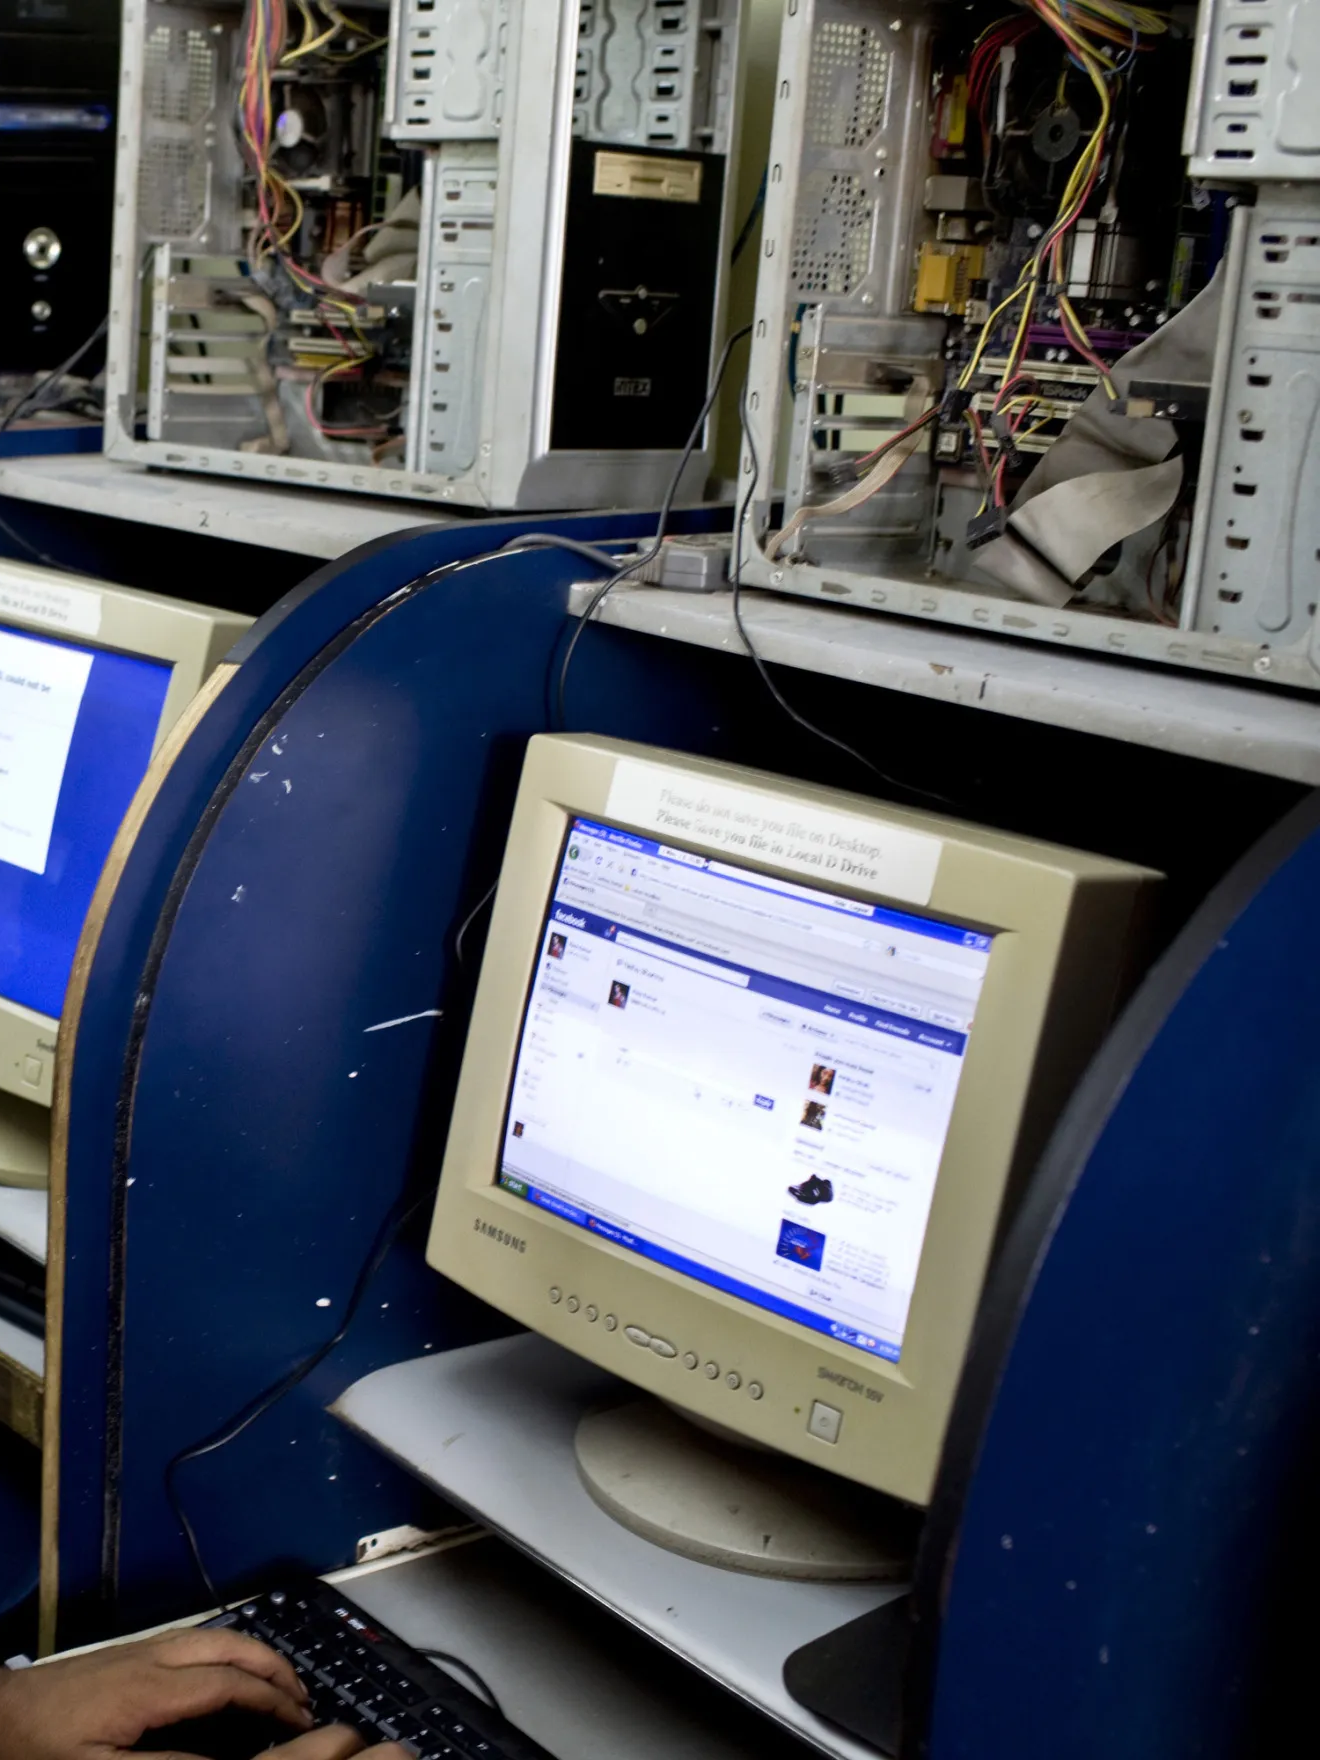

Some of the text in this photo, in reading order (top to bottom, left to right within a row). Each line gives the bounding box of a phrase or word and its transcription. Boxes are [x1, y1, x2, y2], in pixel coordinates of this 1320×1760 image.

[199, 510, 209, 528] 2
[660, 788, 693, 810] Please
[696, 799, 711, 814] do
[712, 807, 731, 820] not
[733, 811, 760, 828] save
[760, 818, 784, 834] you
[786, 821, 806, 840] file
[809, 831, 825, 845] on
[656, 808, 691, 830] Please
[723, 828, 747, 845] you
[748, 834, 768, 851] file
[769, 840, 783, 854] in
[785, 843, 823, 867] Local
[824, 854, 838, 869] D
[840, 858, 878, 880] Drive
[555, 908, 587, 930] facebook
[508, 1177, 523, 1192] start
[474, 1217, 527, 1254] SAMSUNG
